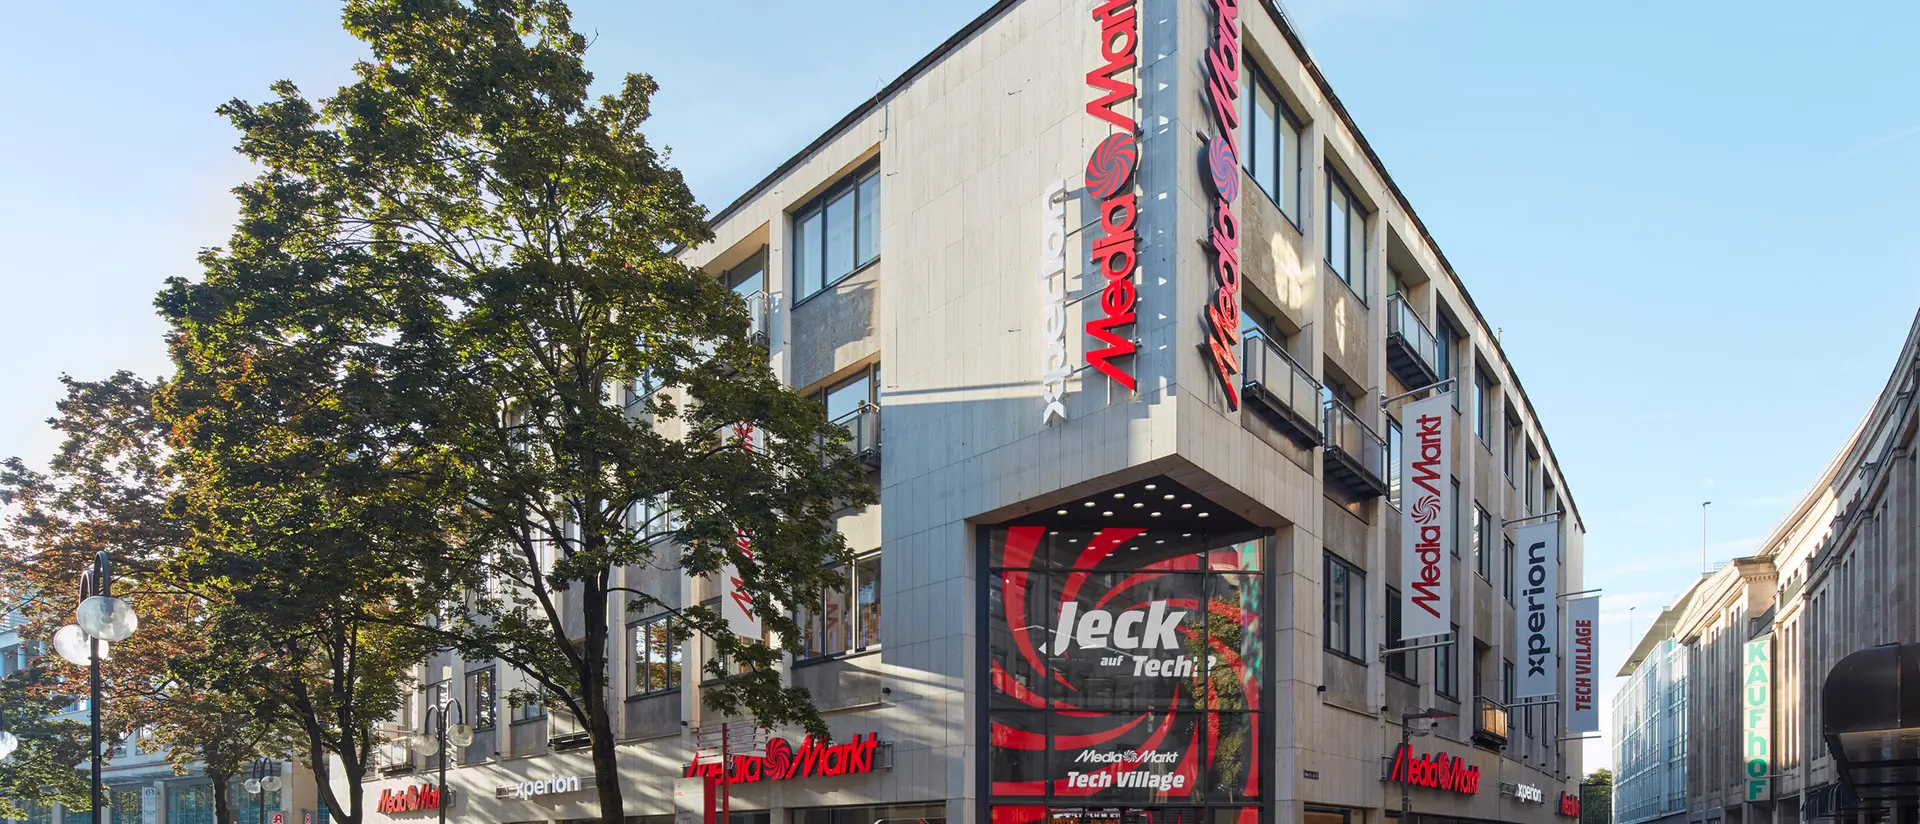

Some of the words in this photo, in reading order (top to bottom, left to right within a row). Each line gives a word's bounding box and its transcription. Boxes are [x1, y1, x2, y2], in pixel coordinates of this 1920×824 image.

[1041, 178, 1074, 427] xperion
[1086, 192, 1139, 391] Media
[1204, 194, 1239, 412] Media
[1411, 414, 1442, 496] Markt
[1411, 526, 1441, 619] Media
[1038, 600, 1187, 656] Jeck
[1523, 541, 1550, 677] xperion
[1100, 656, 1123, 667] auf
[1576, 619, 1592, 673] VILLAGE
[1576, 676, 1592, 711] TECH
[1067, 771, 1112, 788] Tech
[1117, 771, 1185, 791] Village
[1074, 750, 1123, 763] Media
[1136, 750, 1179, 763] Markt
[514, 774, 580, 799] xperion
[1517, 783, 1541, 802] xperion
